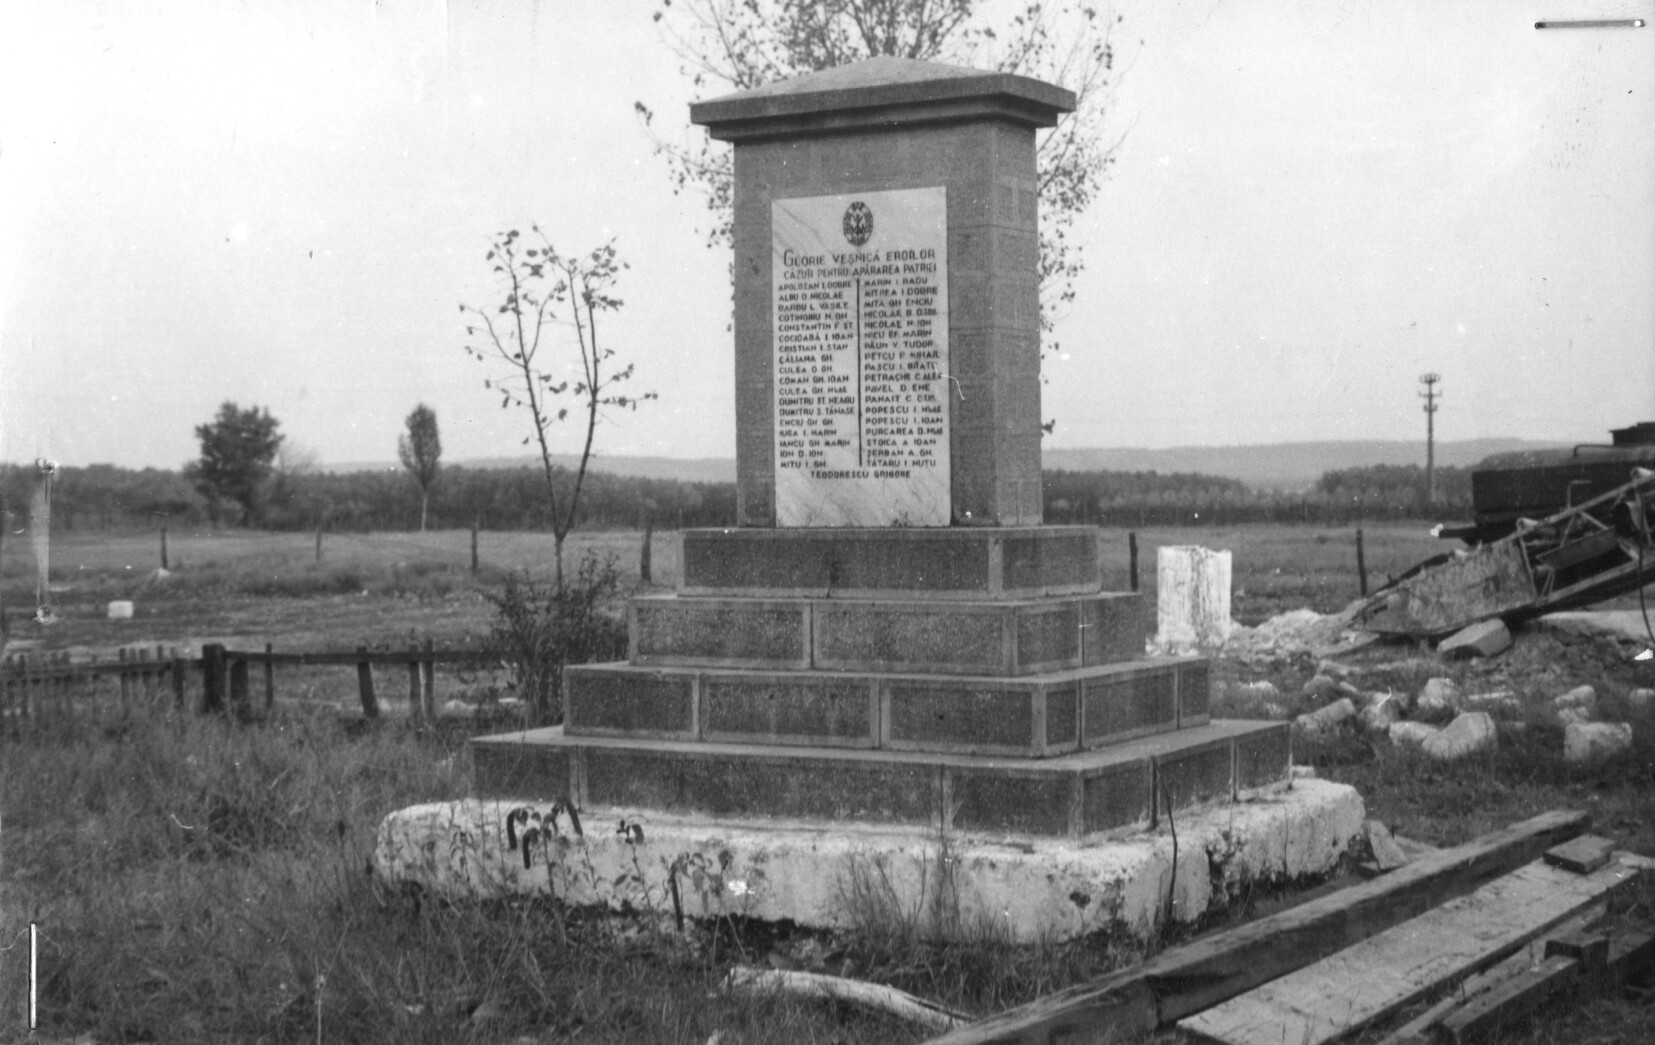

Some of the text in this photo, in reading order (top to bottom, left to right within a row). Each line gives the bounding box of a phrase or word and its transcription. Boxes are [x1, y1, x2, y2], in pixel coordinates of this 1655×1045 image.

[783, 249, 825, 267] GLORIE
[886, 249, 935, 261] EROILOR
[817, 268, 849, 278] PENTRU
[852, 263, 900, 276] APĂRAREA
[903, 262, 937, 273] PATRIEI
[864, 278, 892, 287] MARIN
[902, 276, 928, 285] RADU
[810, 291, 844, 300] NICOLAE
[864, 288, 897, 297] MITREA
[907, 286, 938, 296] DOBRE
[778, 303, 807, 312] BARBU
[819, 301, 849, 310] VASILE
[905, 297, 933, 307] ENCIU
[864, 310, 902, 319] NICOLAE
[778, 323, 832, 332] CONSTANTIN
[864, 320, 902, 329] NICOLAE
[917, 319, 932, 327] ION
[831, 332, 853, 340] IOAN
[864, 330, 885, 339] NICU
[902, 329, 932, 338] MARIN
[778, 344, 817, 353] CRISTIAN
[827, 343, 849, 351] STAN
[903, 340, 933, 348] TUDOR
[864, 351, 895, 360] PETCU
[909, 350, 941, 359] MIHAIL
[779, 365, 807, 374] CULEA
[864, 362, 895, 371] PASCU
[779, 376, 810, 385] COMAN
[827, 374, 850, 383] IOAN
[864, 373, 911, 382] PETRACHE
[779, 387, 808, 395] CULEA
[865, 384, 894, 393] PAVEL
[912, 383, 931, 392] ENE
[779, 397, 814, 406] DUMITRU
[828, 395, 855, 405] NEAGU
[865, 395, 901, 403] PANAIT
[779, 407, 814, 416] DUMITRU
[865, 405, 909, 414] POPESCU
[779, 418, 804, 427] ENCIU
[865, 416, 909, 425] POPESCU
[921, 416, 943, 424] IOAN
[779, 429, 798, 437] IUGA
[811, 428, 837, 437] MARIN
[865, 427, 914, 436] PURCAREA
[779, 439, 805, 448] IANCU
[824, 438, 851, 447] MARIN
[867, 438, 897, 446] STOICA
[913, 438, 937, 446] IOAN
[779, 449, 794, 458] ION
[808, 449, 823, 458] ION
[780, 460, 802, 469] MITU
[810, 470, 911, 479] TEODORESCU GRIGORE
